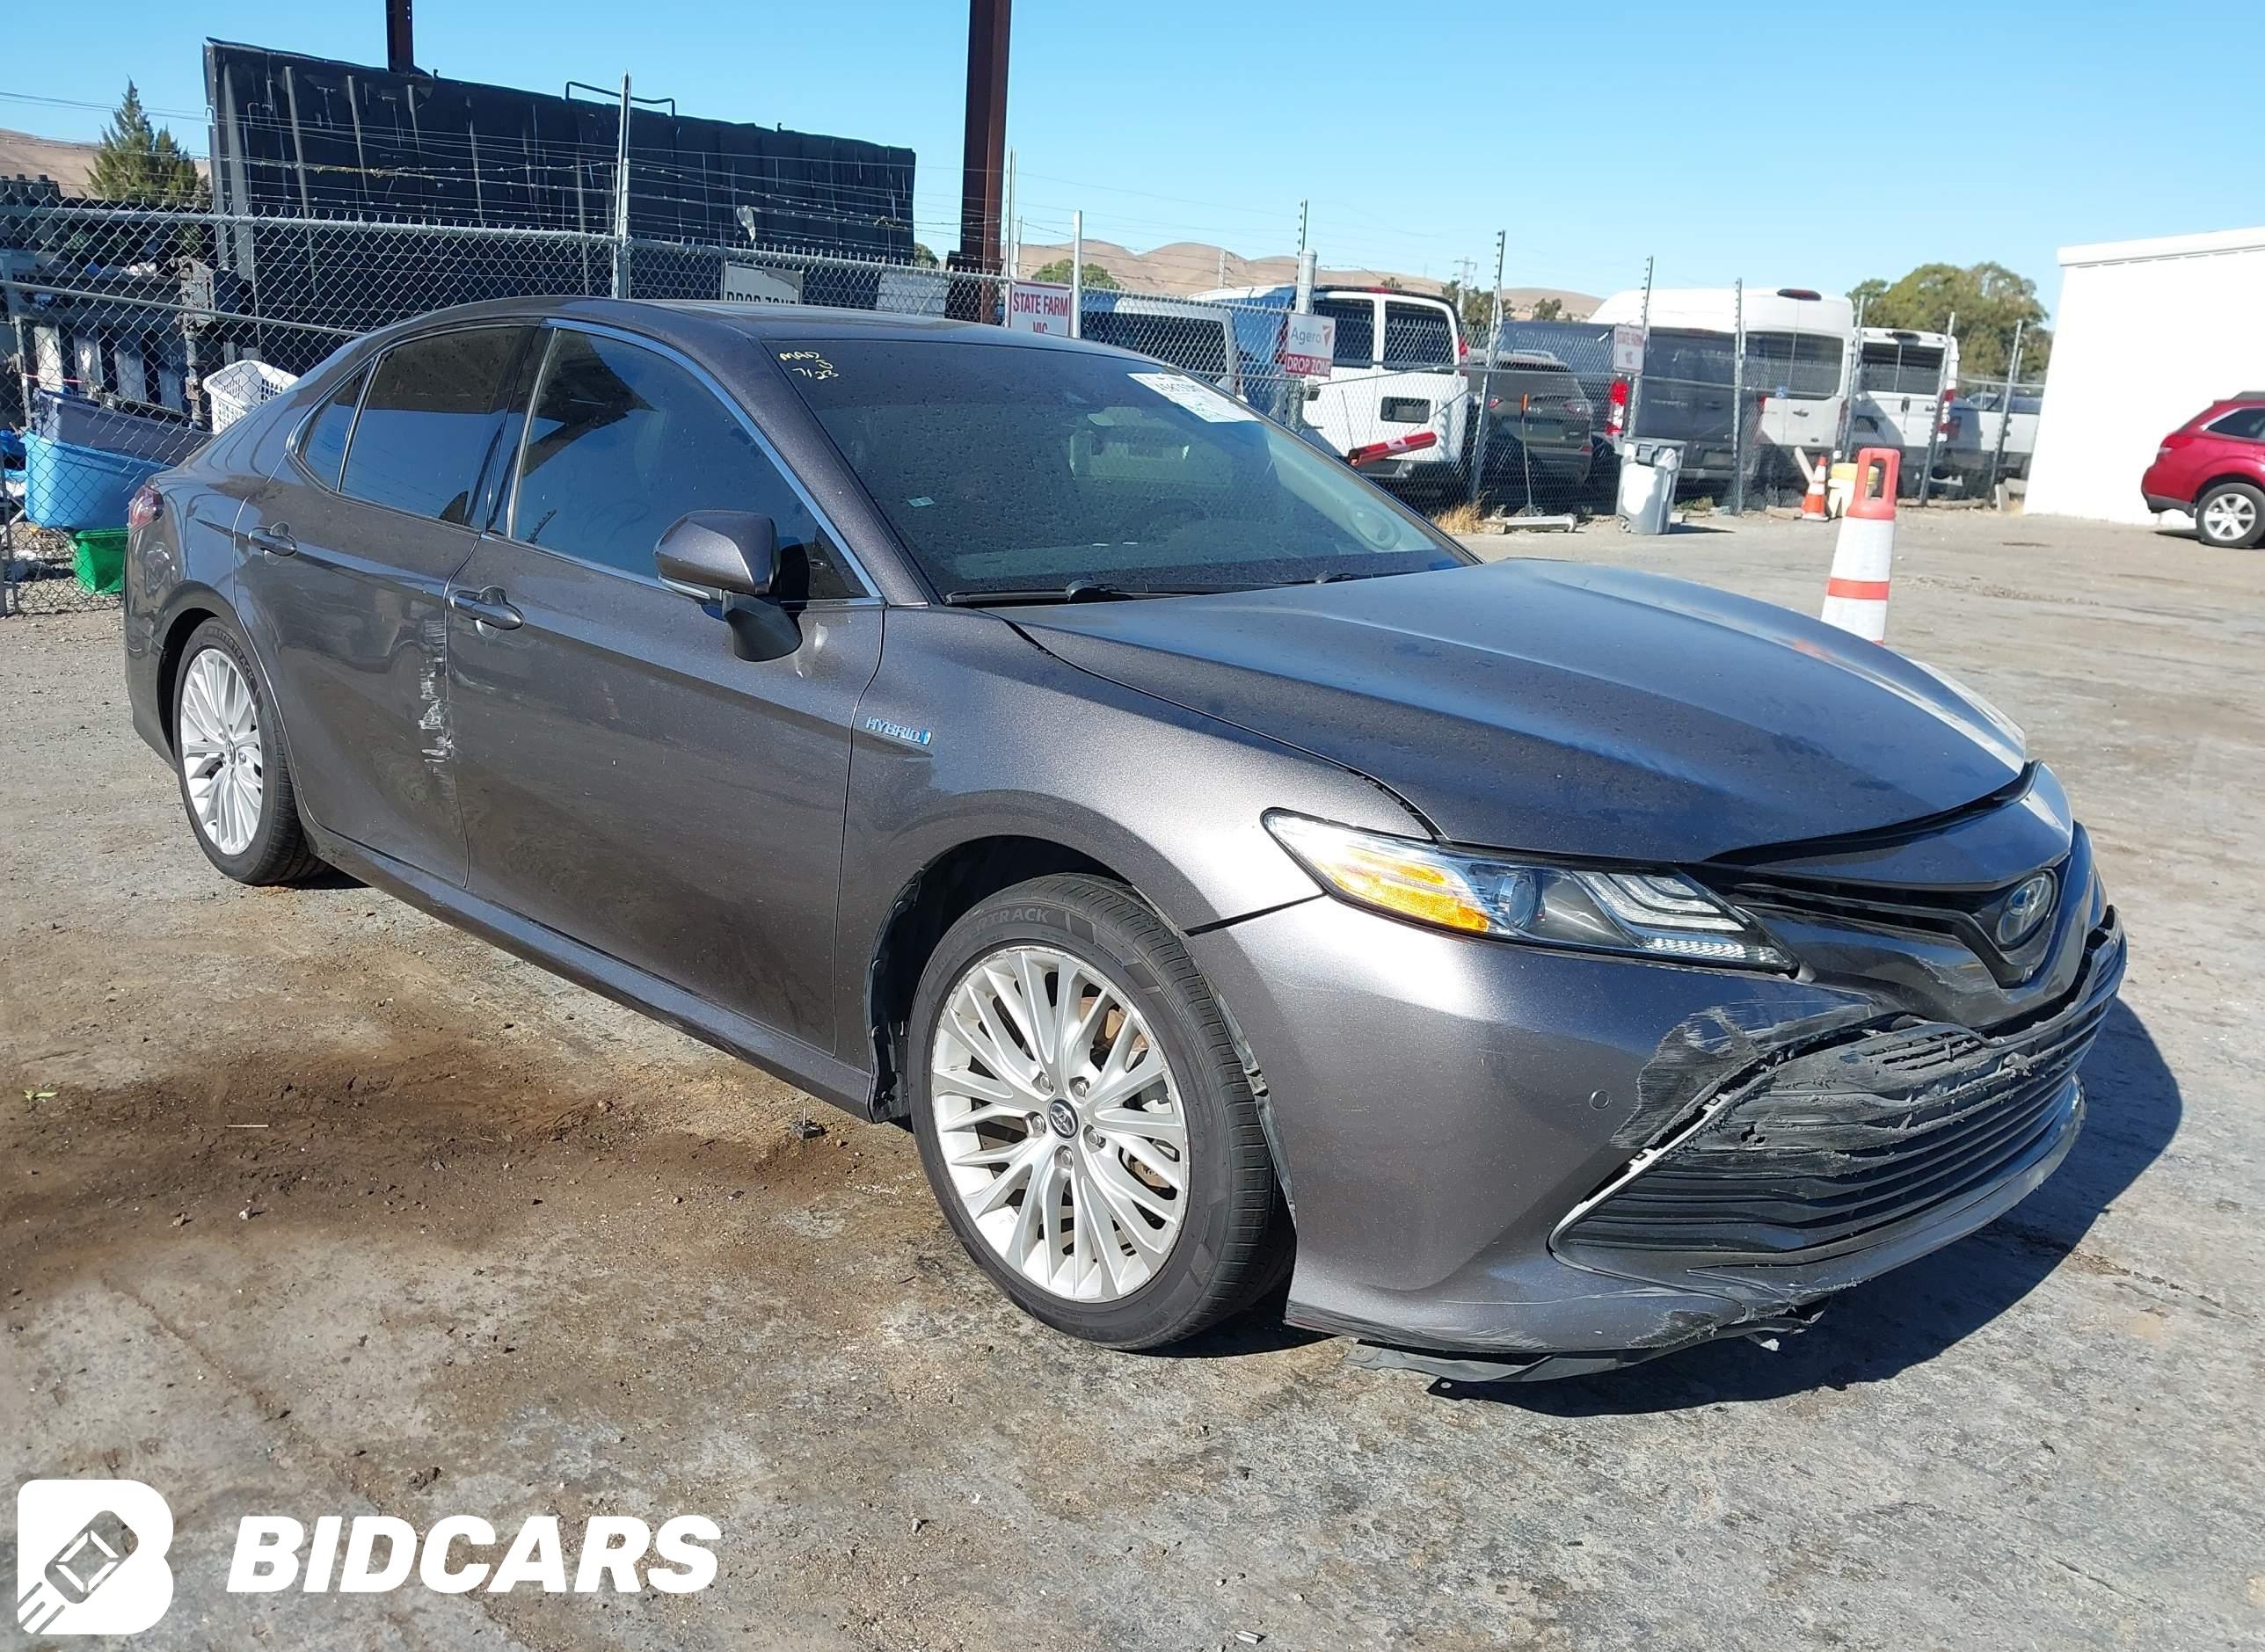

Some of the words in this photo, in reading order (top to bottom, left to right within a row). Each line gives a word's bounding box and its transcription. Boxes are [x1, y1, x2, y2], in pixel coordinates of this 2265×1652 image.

[1013, 292, 1041, 315] STATE
[1044, 295, 1068, 317] FARM
[1290, 326, 1322, 345] Agero
[1286, 355, 1311, 373] DROP
[1311, 359, 1331, 375] ZONE
[865, 717, 922, 744] HYBRID
